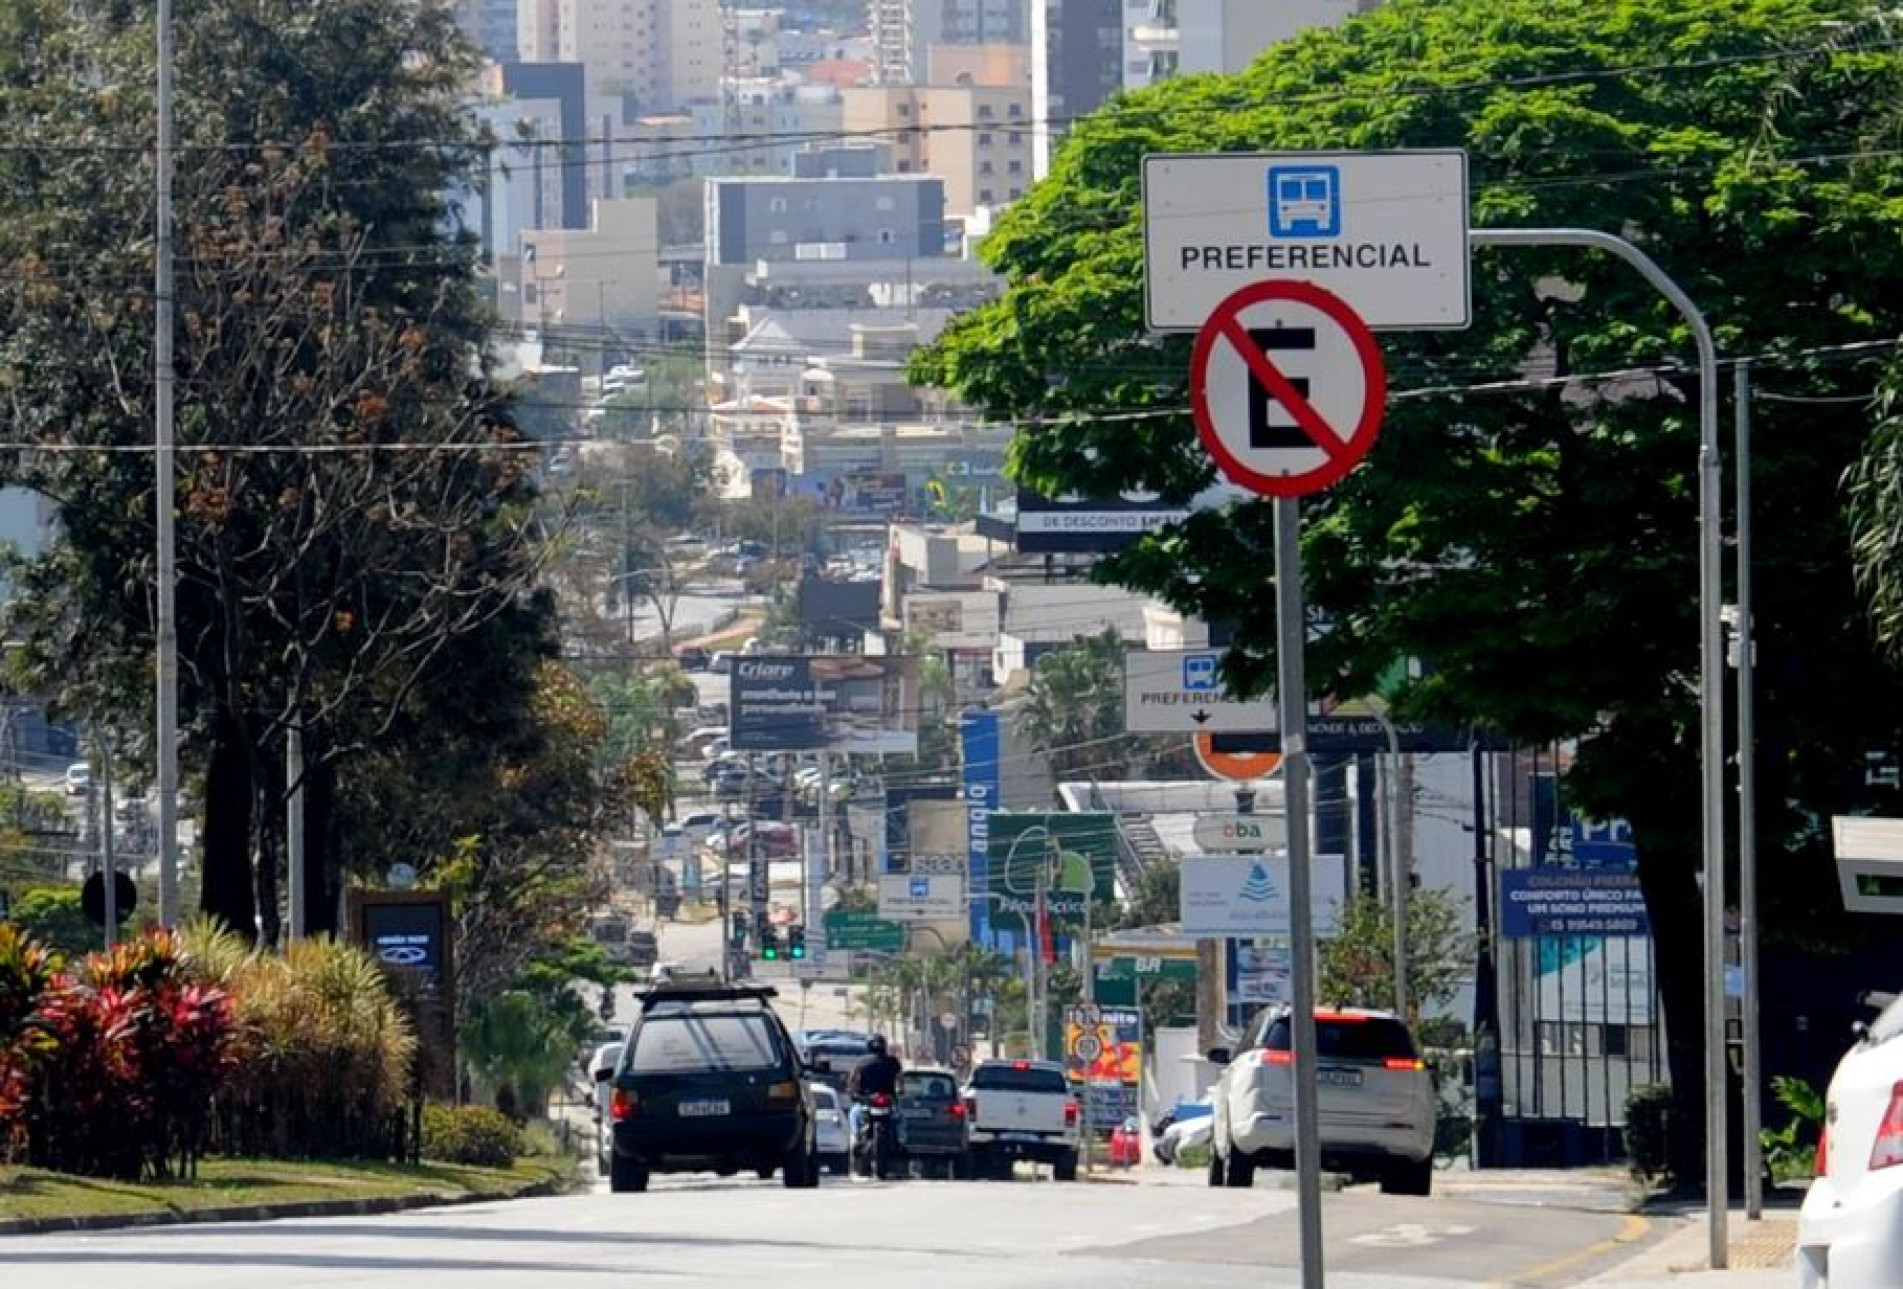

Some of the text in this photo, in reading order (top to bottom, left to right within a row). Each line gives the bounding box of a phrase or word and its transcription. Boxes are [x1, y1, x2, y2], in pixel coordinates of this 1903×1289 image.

[1180, 242, 1431, 270] PREFERENCIAL
[1247, 328, 1317, 449] E
[1509, 889, 1581, 902] CONFORTO
